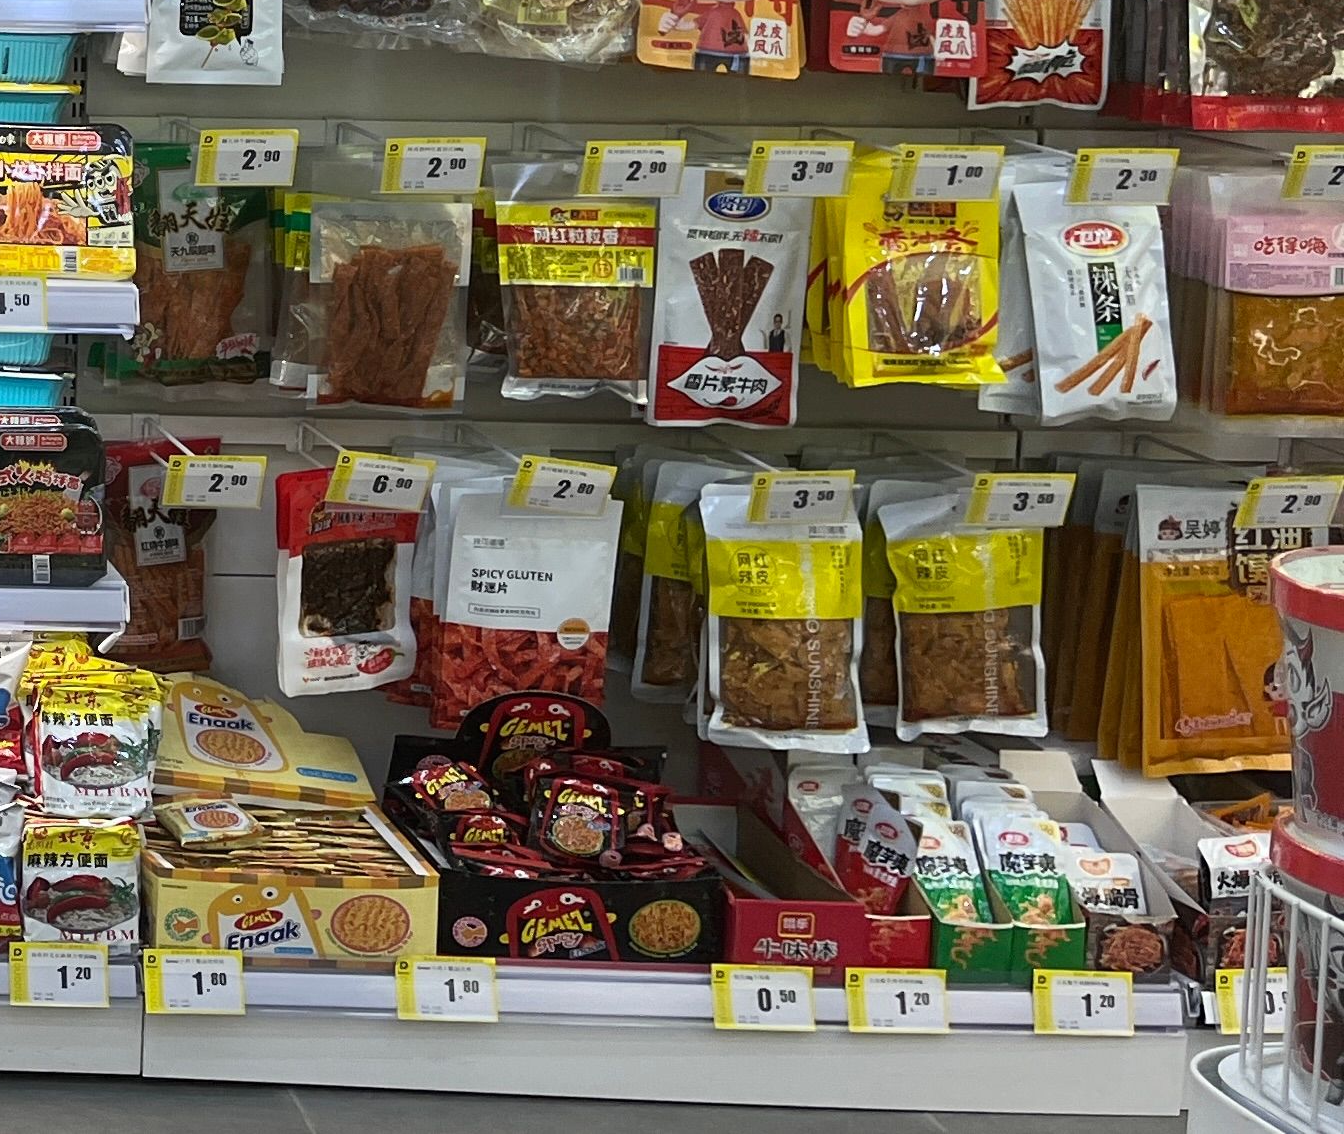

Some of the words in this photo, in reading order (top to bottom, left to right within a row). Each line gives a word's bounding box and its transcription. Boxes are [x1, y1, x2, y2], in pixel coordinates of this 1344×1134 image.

[242, 148, 281, 171] 2.90
[427, 157, 467, 179] 2.90
[626, 160, 667, 182] 2.90
[792, 161, 833, 182] 3.90
[1254, 237, 1329, 256] 吃得嗨
[209, 473, 248, 495] 2.90
[371, 475, 412, 496] 6.90
[793, 490, 834, 509] 3.50
[1013, 492, 1054, 512] 3.50
[1185, 520, 1221, 539] 吴婷
[471, 568, 504, 580] SPICY
[507, 570, 553, 583] GLUTEN
[188, 712, 255, 730] Enaak
[499, 718, 569, 741] GEMEZ
[26, 852, 109, 869] 麻辣方便面
[226, 923, 299, 950] Enaak
[521, 909, 593, 943] GEMEZ
[753, 936, 839, 962] 牛味棒
[57, 967, 92, 990] 1.20
[757, 987, 797, 1011] 0.50
[896, 990, 930, 1014] 1.20
[1081, 993, 1115, 1017] 1.20
